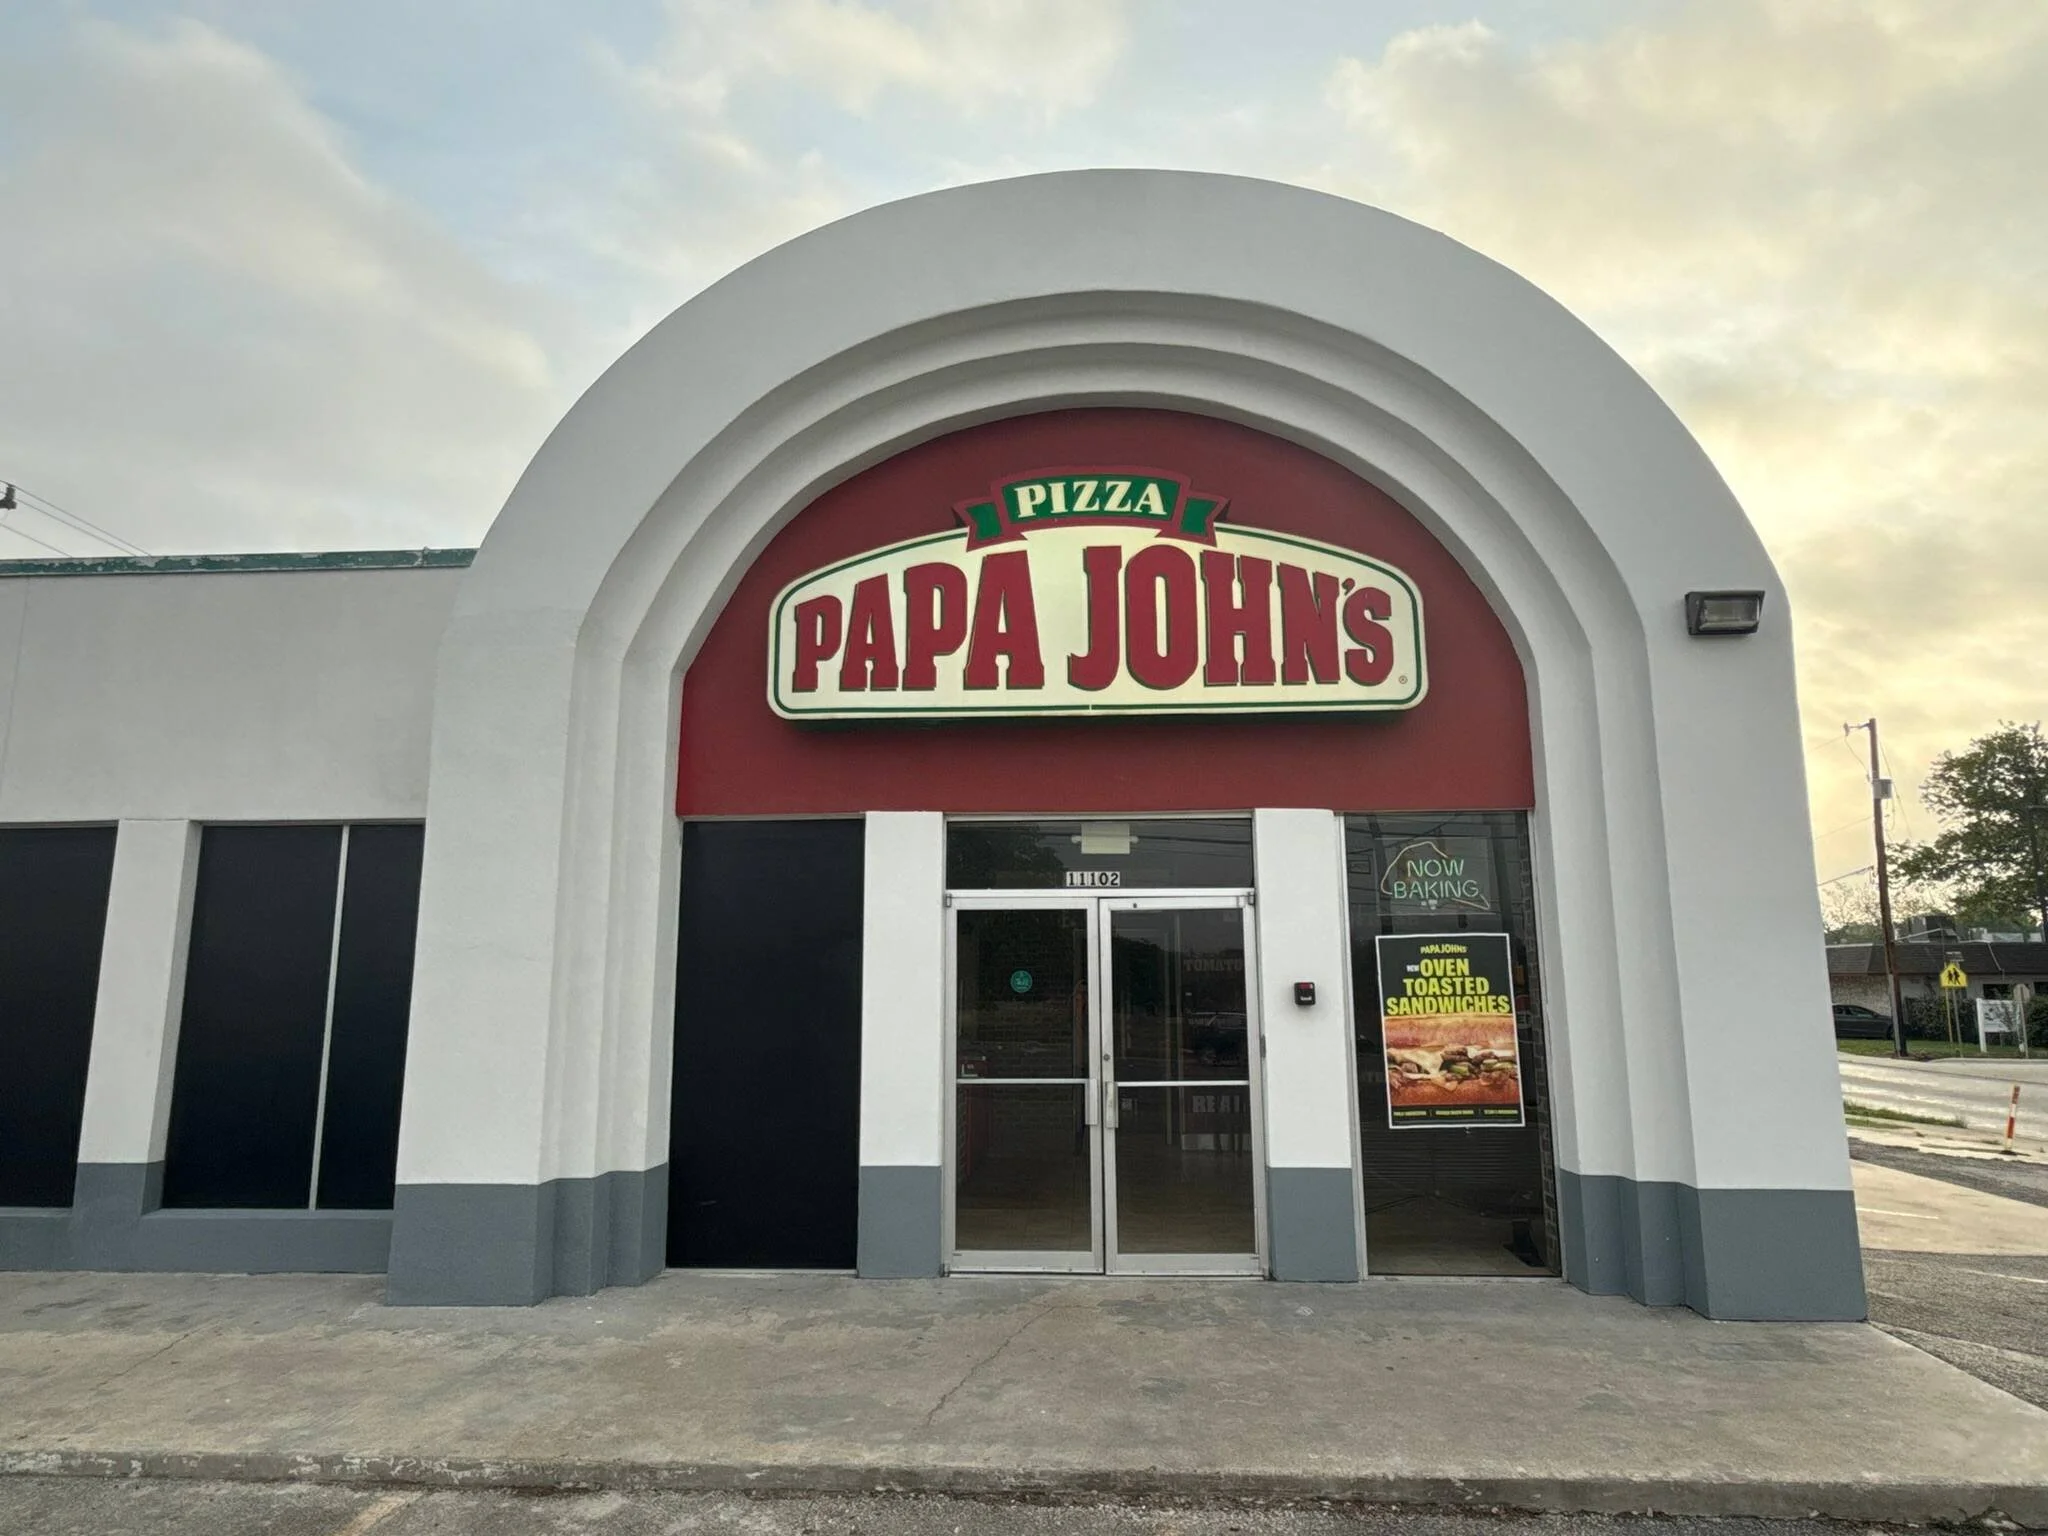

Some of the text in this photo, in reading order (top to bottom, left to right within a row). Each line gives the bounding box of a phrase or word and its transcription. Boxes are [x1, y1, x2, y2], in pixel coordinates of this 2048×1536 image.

[1014, 480, 1168, 518] PIZZA
[792, 544, 1393, 692] PAPA JOHN'S
[1408, 859, 1464, 877] NOW
[1069, 872, 1119, 885] 11102
[1394, 880, 1479, 899] BAKING
[1420, 958, 1470, 977] OVEN
[1403, 977, 1490, 996] TOASTED
[1386, 995, 1511, 1016] SANDWICHES
